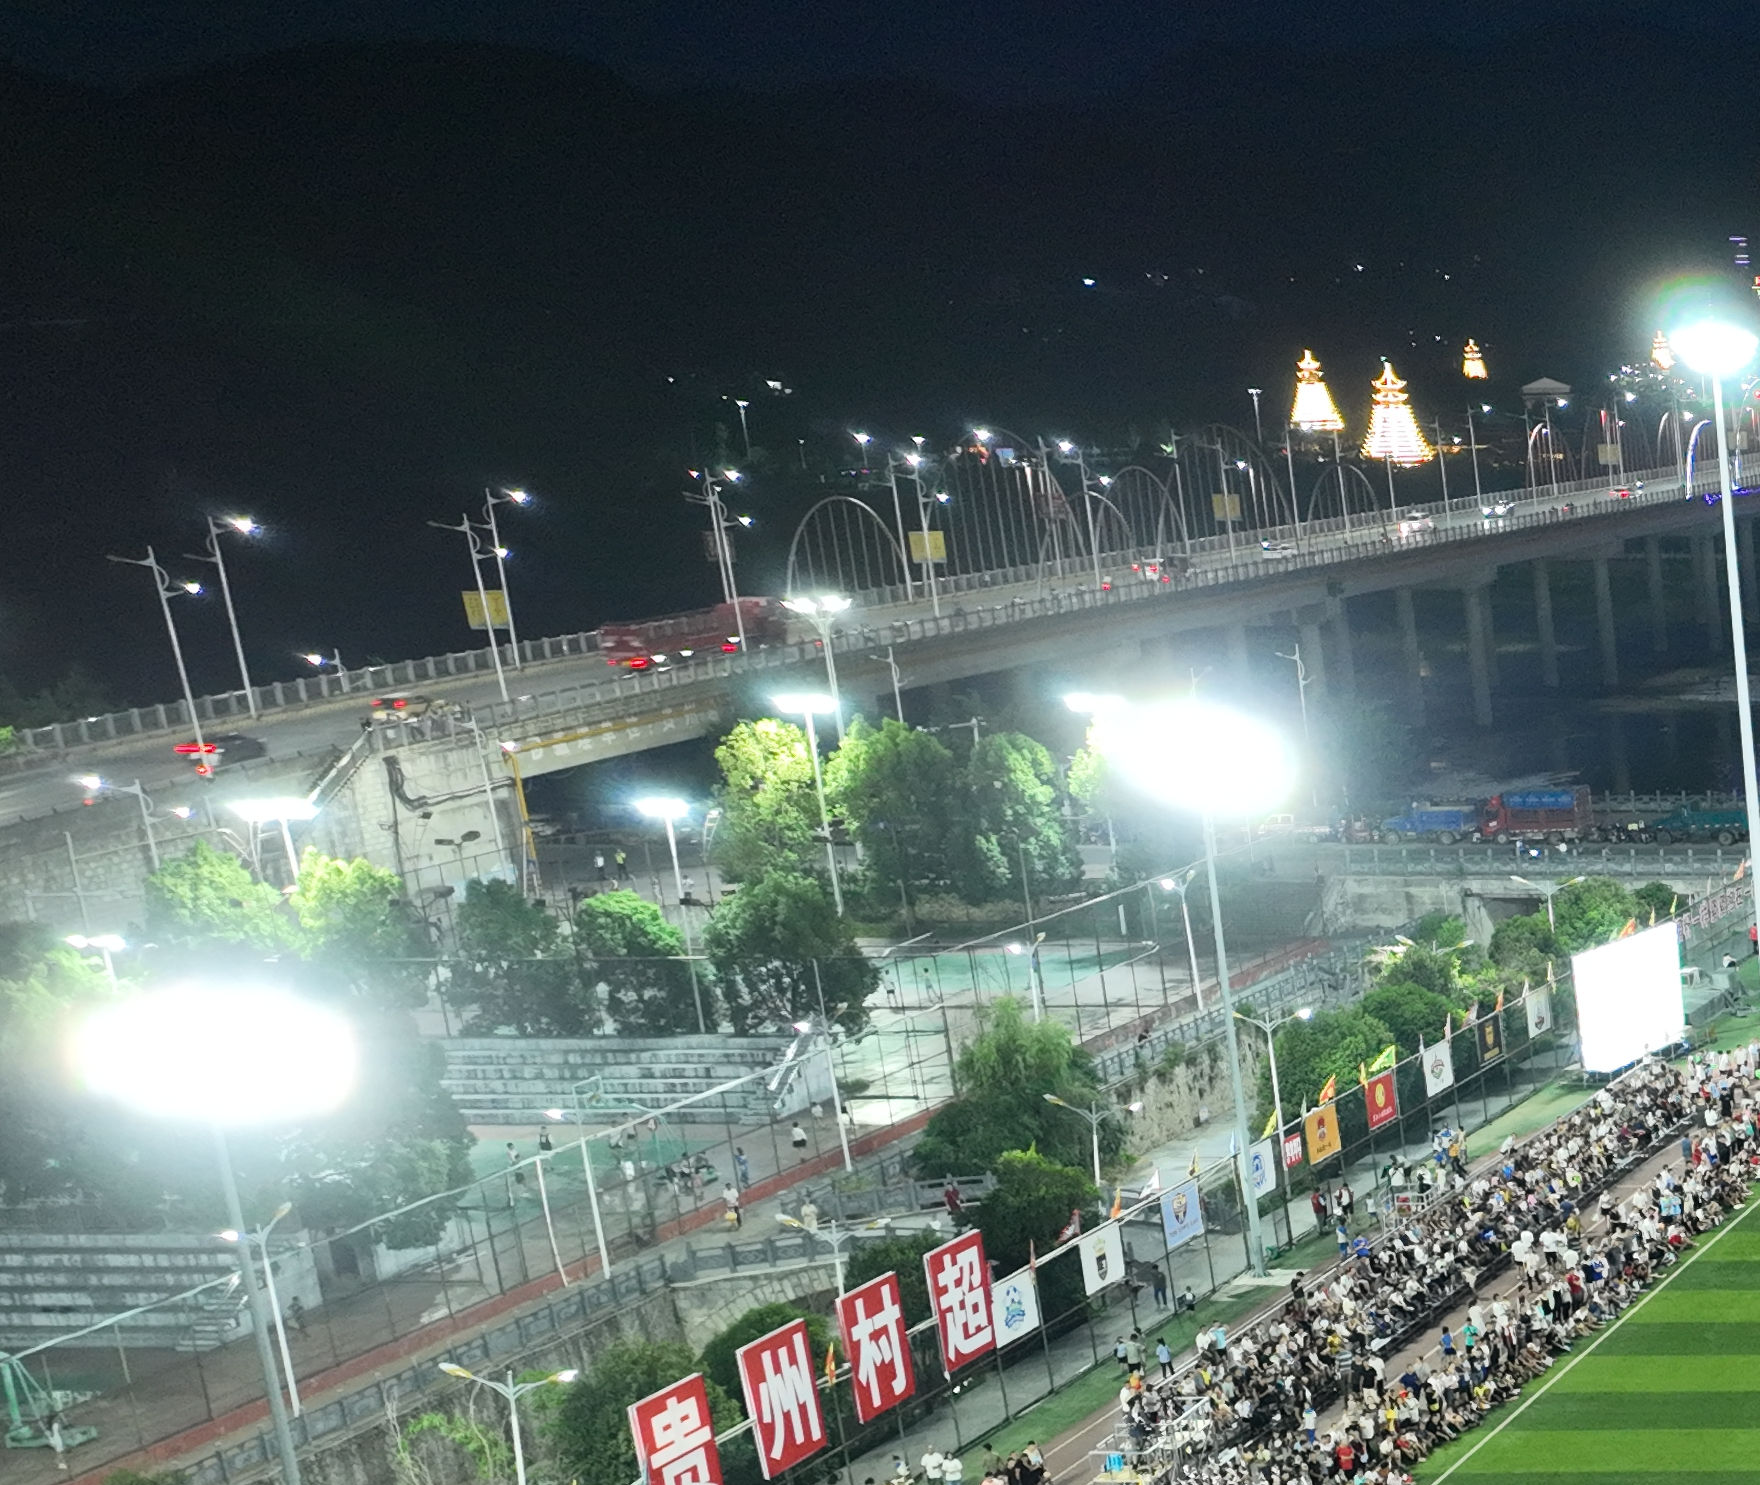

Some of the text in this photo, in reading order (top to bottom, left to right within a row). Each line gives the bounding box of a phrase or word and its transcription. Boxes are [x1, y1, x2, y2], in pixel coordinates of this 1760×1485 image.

[759, 1332, 822, 1461] 州
[852, 1283, 908, 1408] 村
[937, 1245, 994, 1362] 超
